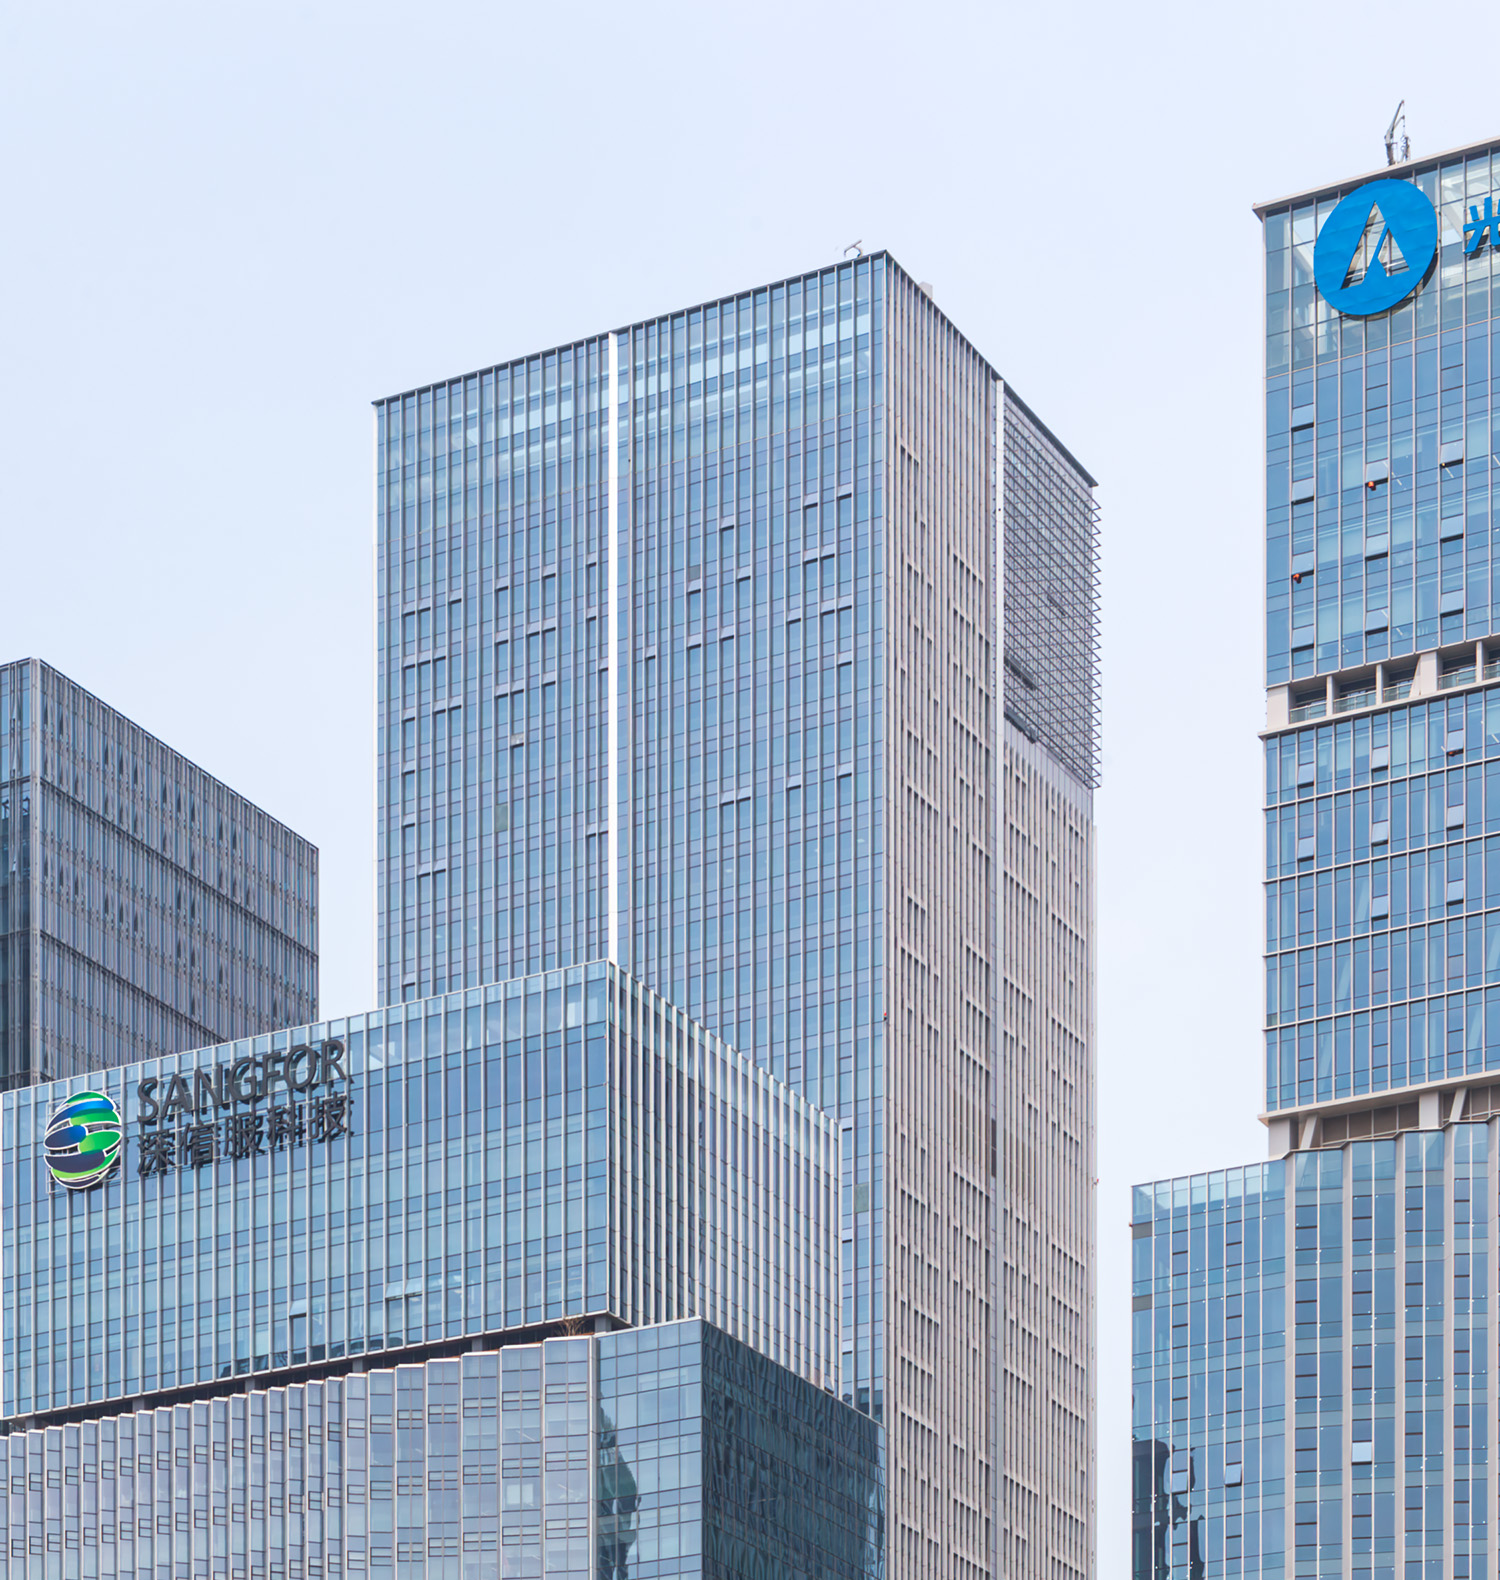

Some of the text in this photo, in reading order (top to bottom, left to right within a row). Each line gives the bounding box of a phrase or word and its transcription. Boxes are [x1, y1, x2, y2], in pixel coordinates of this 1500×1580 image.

[137, 1039, 347, 1123] SANGFOR
[137, 1092, 348, 1174] 深信服科技
